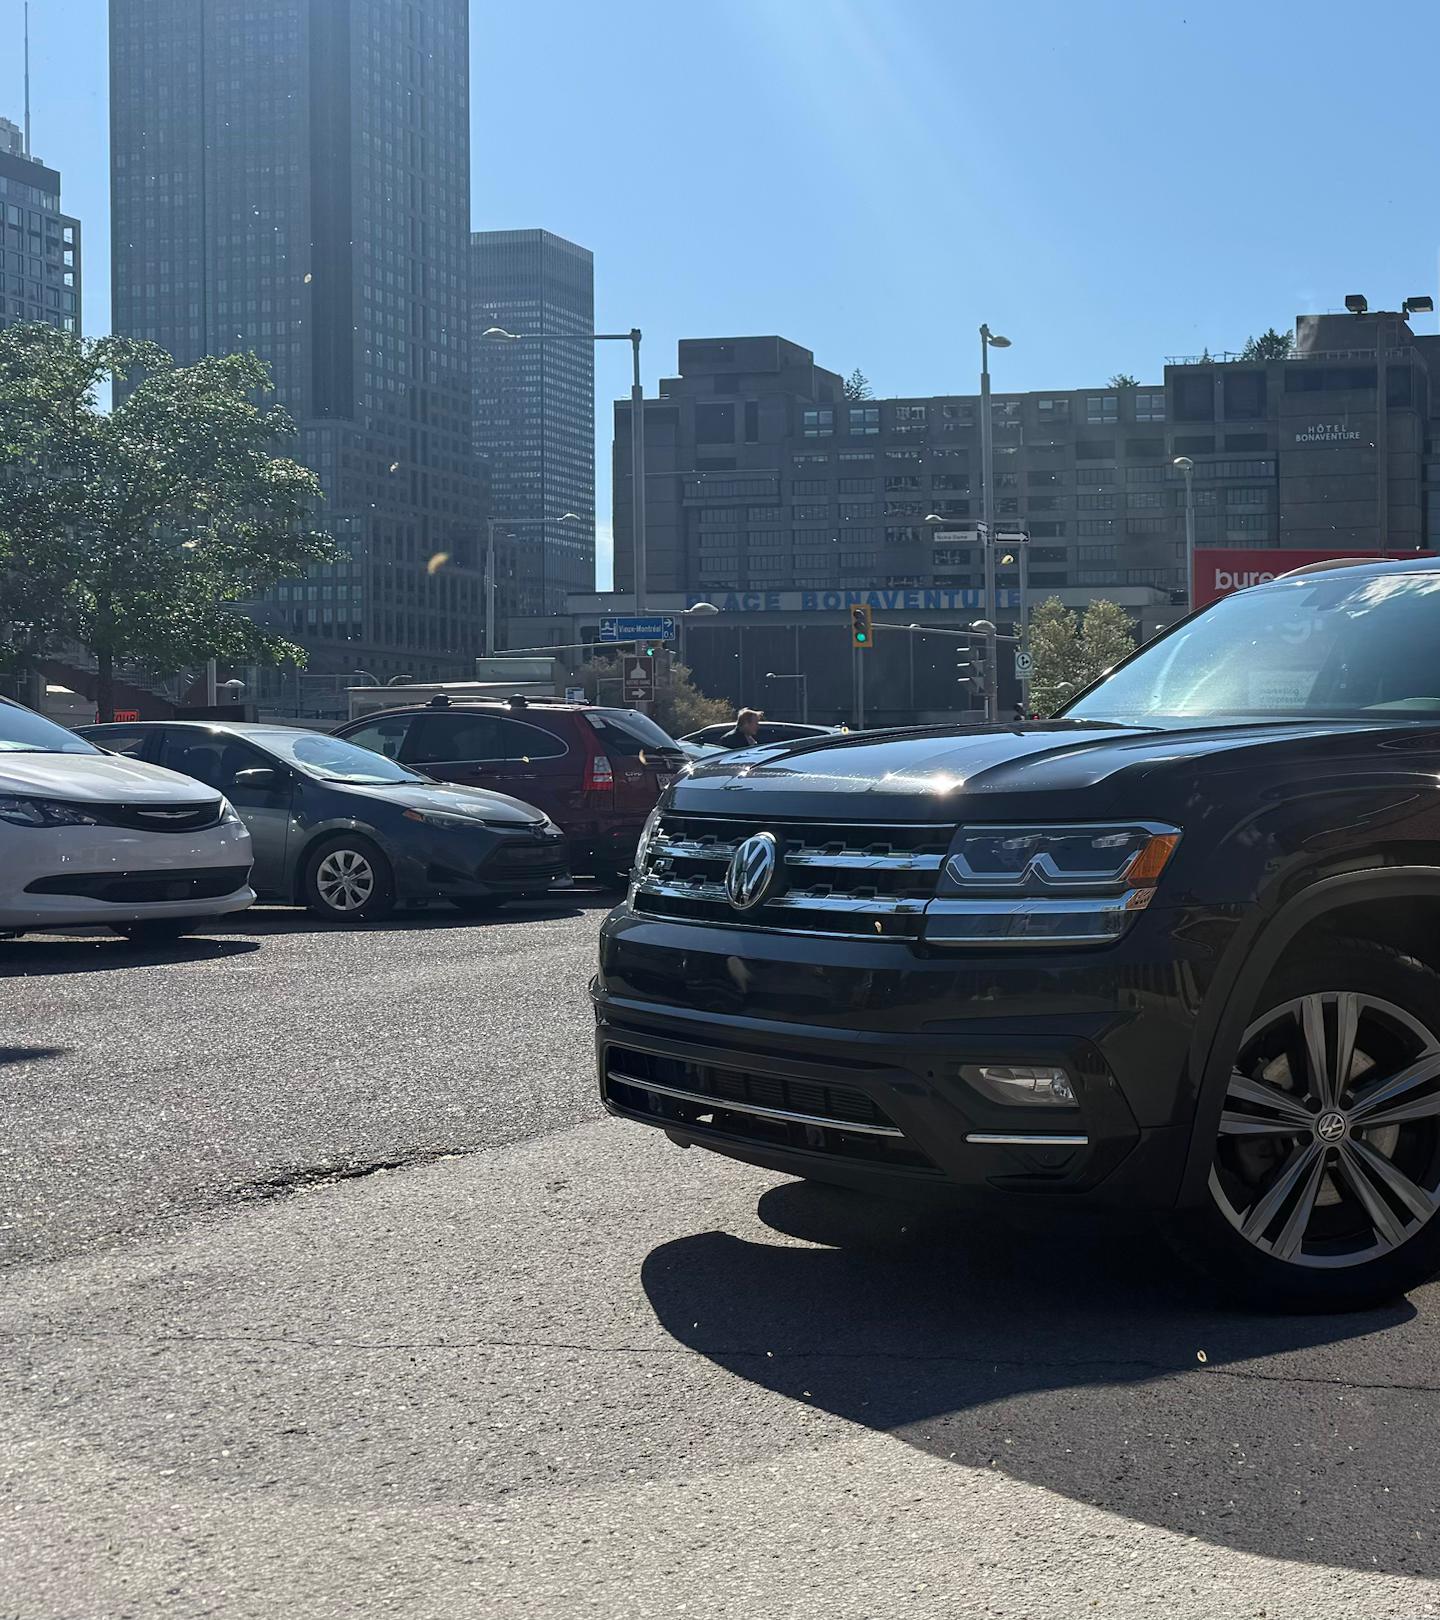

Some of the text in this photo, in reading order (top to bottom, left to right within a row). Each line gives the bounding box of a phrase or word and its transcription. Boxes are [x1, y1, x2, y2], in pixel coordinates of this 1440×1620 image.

[1308, 424, 1347, 433] HÔTEL
[1295, 431, 1361, 442] BONAVENTURE
[1214, 567, 1276, 590] bure
